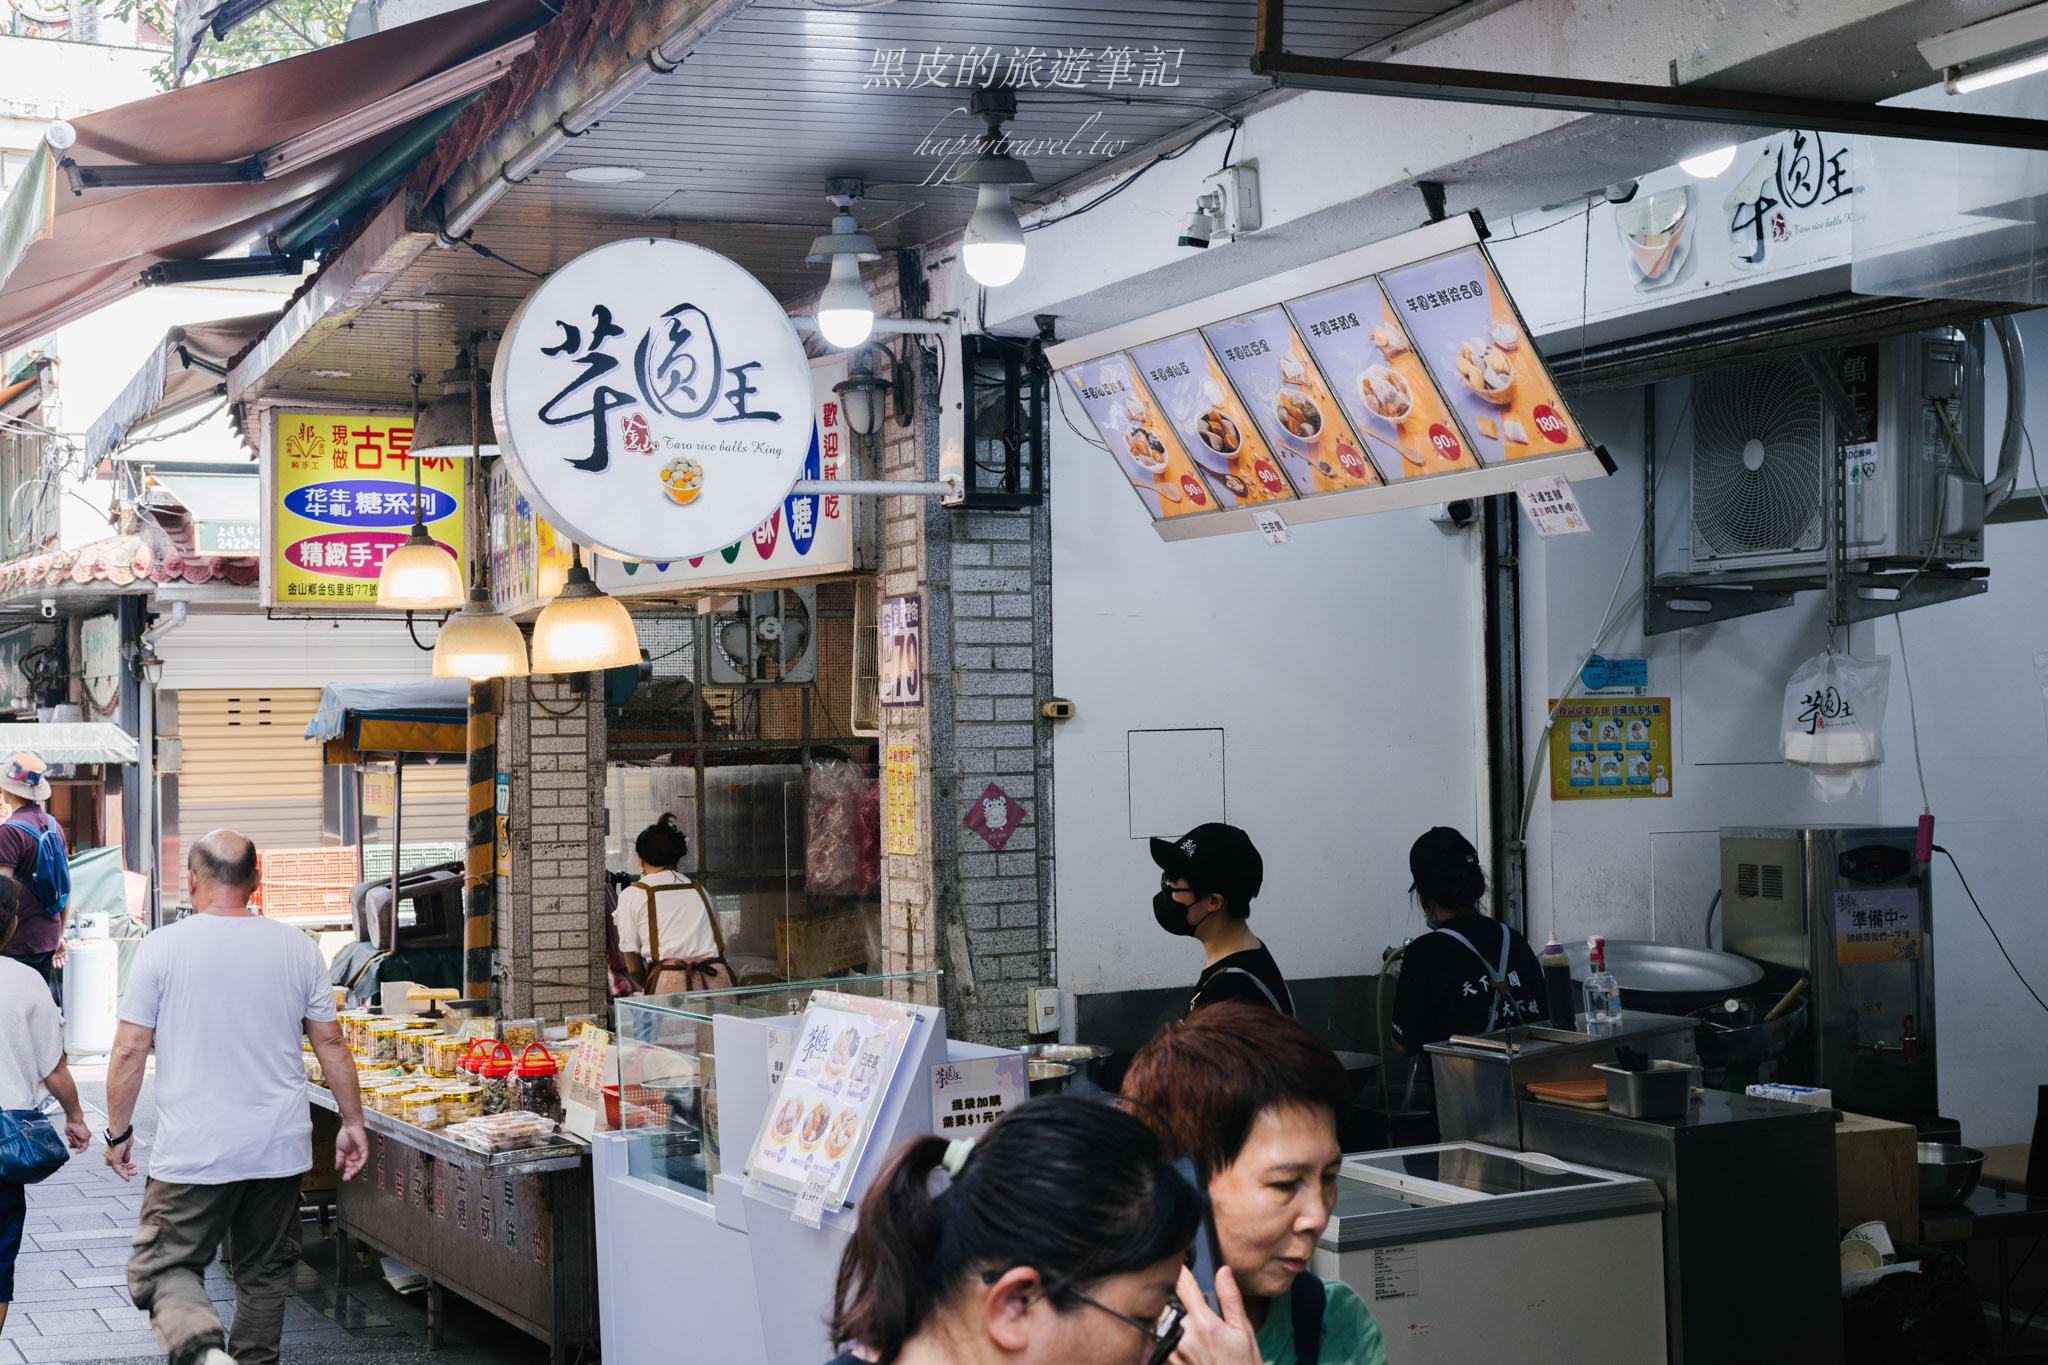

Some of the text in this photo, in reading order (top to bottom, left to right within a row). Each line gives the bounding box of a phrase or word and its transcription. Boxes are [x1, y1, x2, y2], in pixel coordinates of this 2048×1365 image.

[538, 302, 782, 472] 芋圓王
[298, 422, 315, 443] 郭
[331, 424, 349, 470] 現做
[663, 436, 783, 460] Taro rice balls King
[304, 488, 352, 503] 花生
[355, 491, 436, 516] 糖系列
[304, 503, 352, 517] 牛軋
[300, 542, 400, 568] 精緻手工
[894, 633, 918, 697] 79
[1797, 686, 1853, 736] 芋圓王
[1462, 970, 1521, 997] 天下圓
[801, 1024, 831, 1063] 芋圓王
[935, 1065, 963, 1089] 芋圓王
[951, 1094, 1002, 1111] 提袋加購
